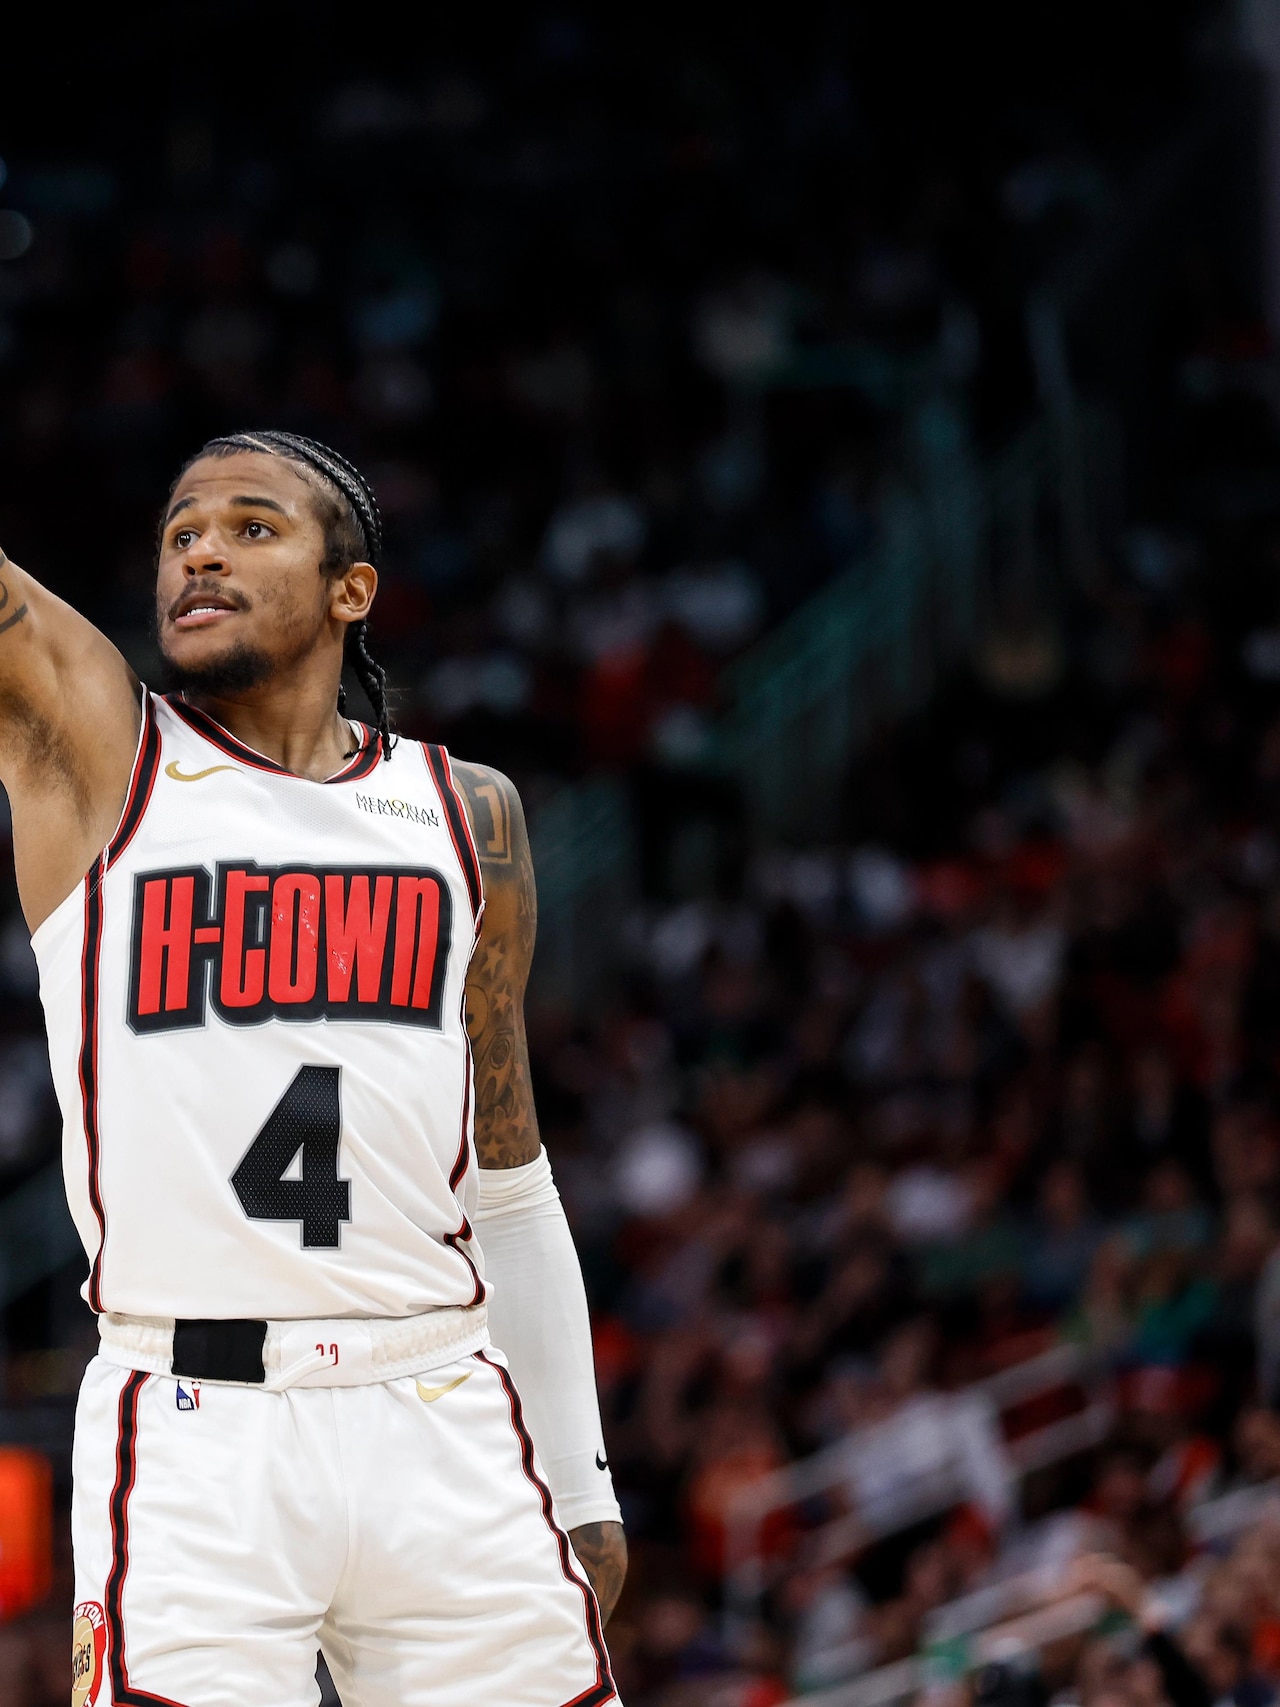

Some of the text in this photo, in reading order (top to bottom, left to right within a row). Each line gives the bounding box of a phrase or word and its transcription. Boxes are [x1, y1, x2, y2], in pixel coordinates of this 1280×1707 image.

[355, 791, 439, 819] MEMORIAL
[357, 803, 439, 827] HERMANN
[228, 1063, 352, 1250] 4
[178, 1398, 192, 1410] NBA
[74, 1603, 105, 1630] STON
